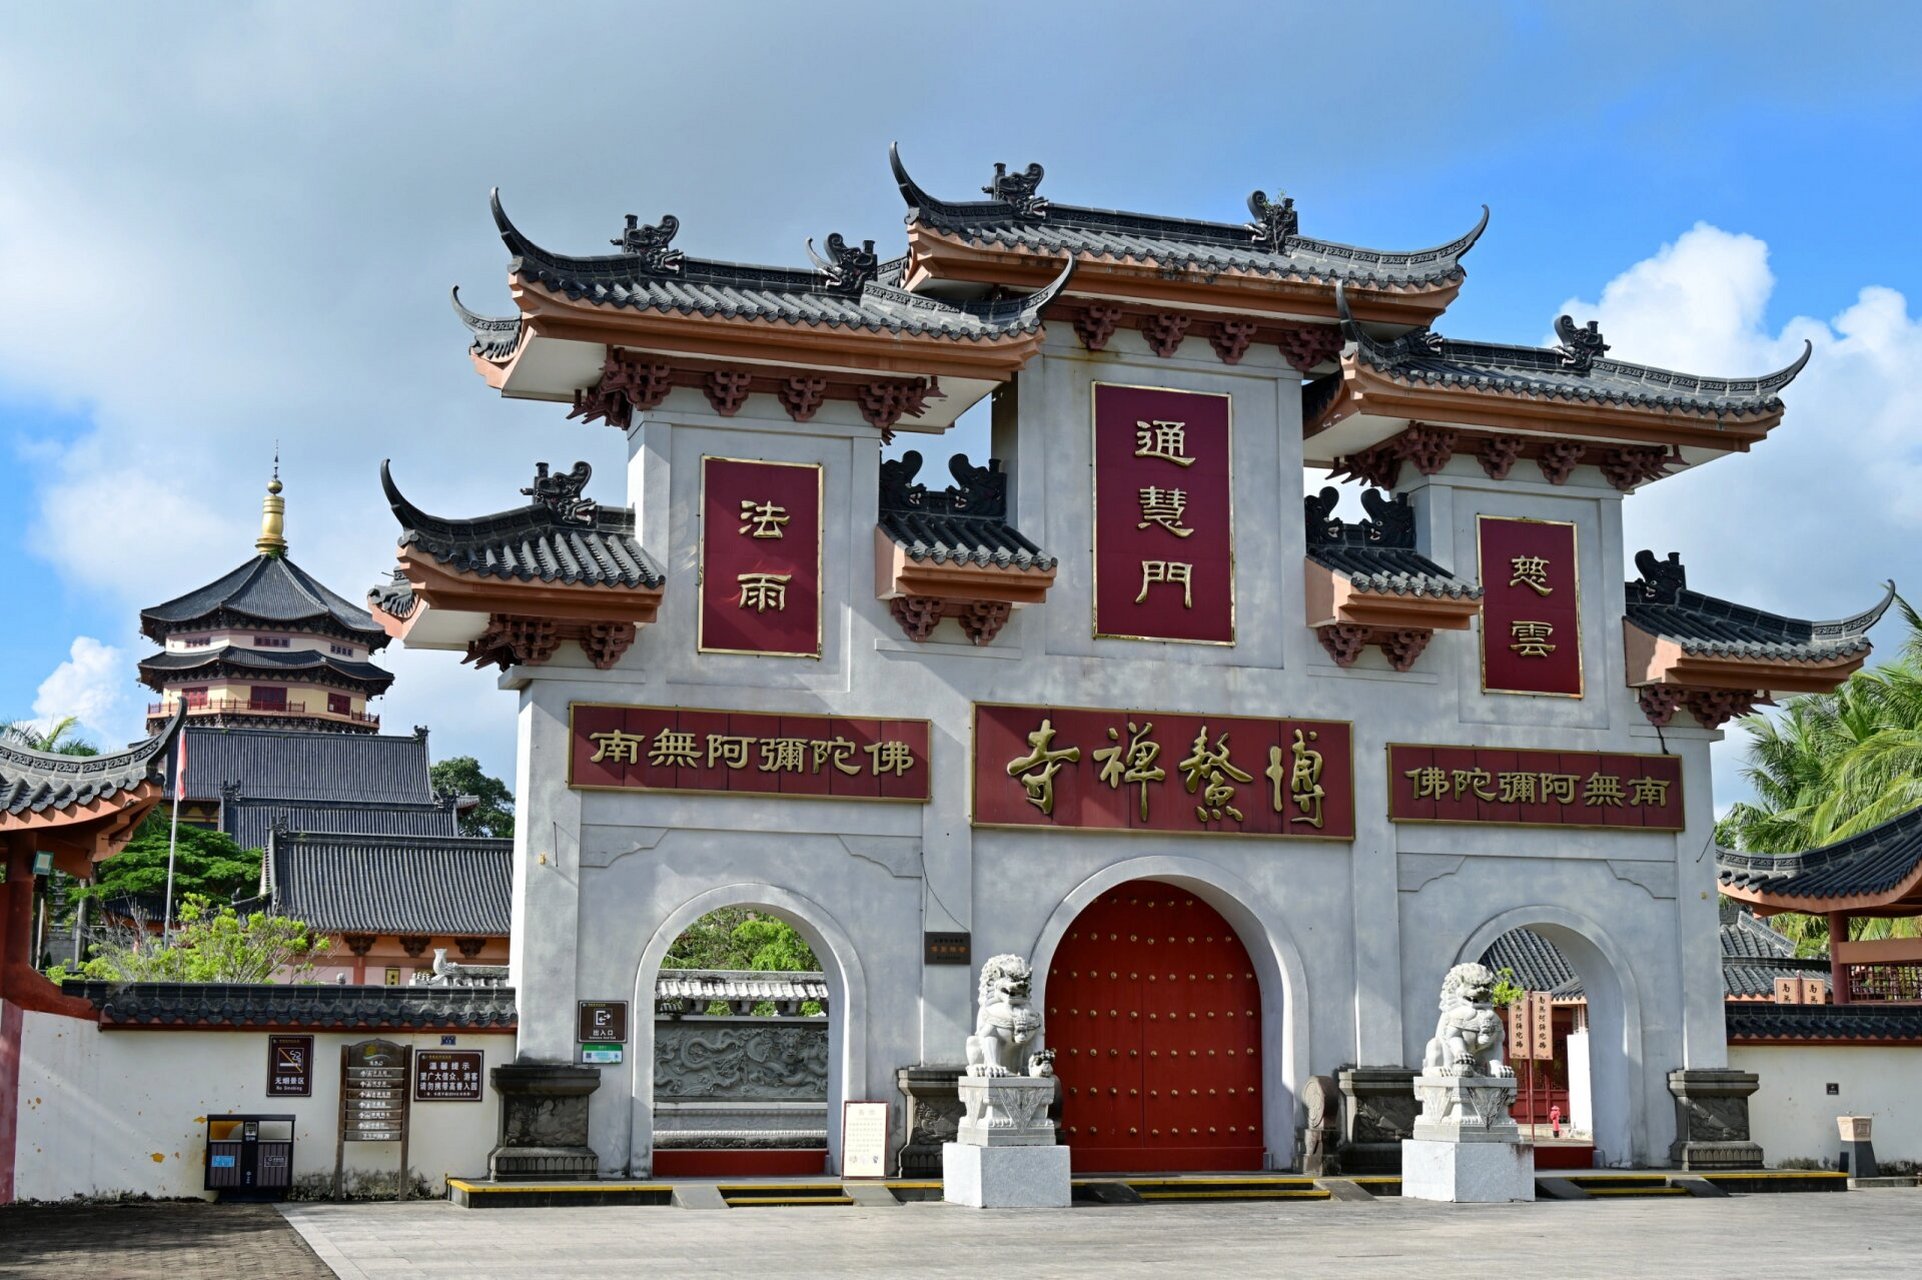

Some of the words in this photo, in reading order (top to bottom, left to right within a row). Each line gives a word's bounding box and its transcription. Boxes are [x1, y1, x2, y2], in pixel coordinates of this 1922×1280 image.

[737, 499, 793, 613] 法雨
[1134, 419, 1197, 609] 通慧門
[1509, 554, 1557, 658] 慈雲
[588, 727, 915, 777] 南無阿彌陀佛
[429, 1061, 470, 1070] 温馨提示
